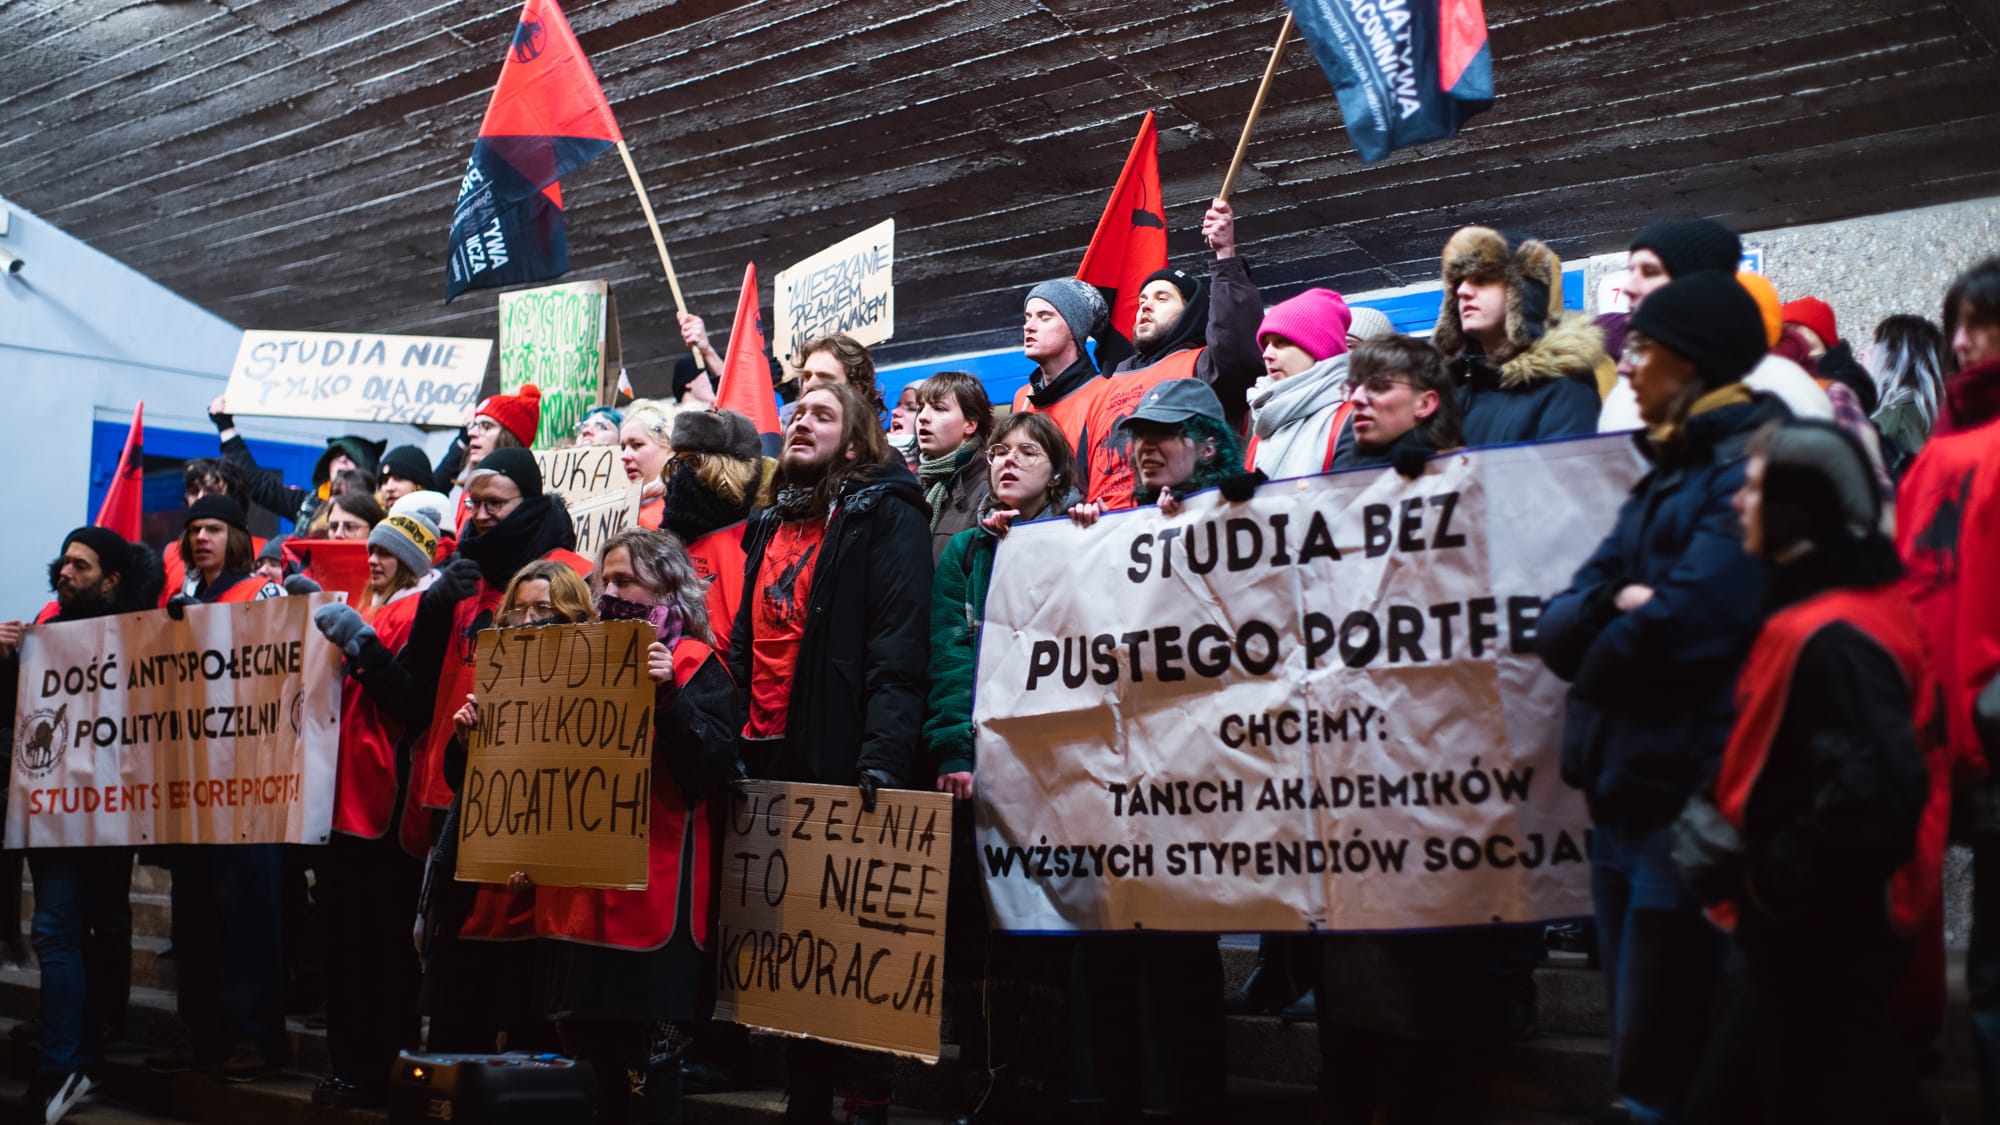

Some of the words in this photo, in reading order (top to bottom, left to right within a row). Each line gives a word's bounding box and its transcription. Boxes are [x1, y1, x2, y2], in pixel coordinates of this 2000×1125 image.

[790, 244, 889, 309] MIESZKANIE
[244, 339, 386, 379] STUDIA
[401, 342, 464, 370] NIE
[256, 375, 352, 406] TYLKO
[1127, 509, 1341, 584] STUDIA
[1362, 491, 1467, 560] BEZ
[41, 654, 118, 698] DOŚĆ
[482, 628, 639, 693] STUDIA
[1025, 620, 1280, 691] PUSTEGO
[1218, 706, 1388, 749] CHCEMY:
[30, 782, 160, 816] STUDENTS
[462, 766, 650, 842] BOGATYCH!
[1109, 777, 1244, 818] TANICH
[1255, 756, 1534, 810] AKADEMIKÓW
[732, 794, 937, 857] UCZELNIA
[984, 834, 1155, 879] WYŻSZYCH
[1165, 830, 1408, 877] STYPENDIÓW
[734, 848, 789, 907] TO
[819, 854, 943, 920] NIEEE
[719, 928, 937, 1016] KORPORACJA
